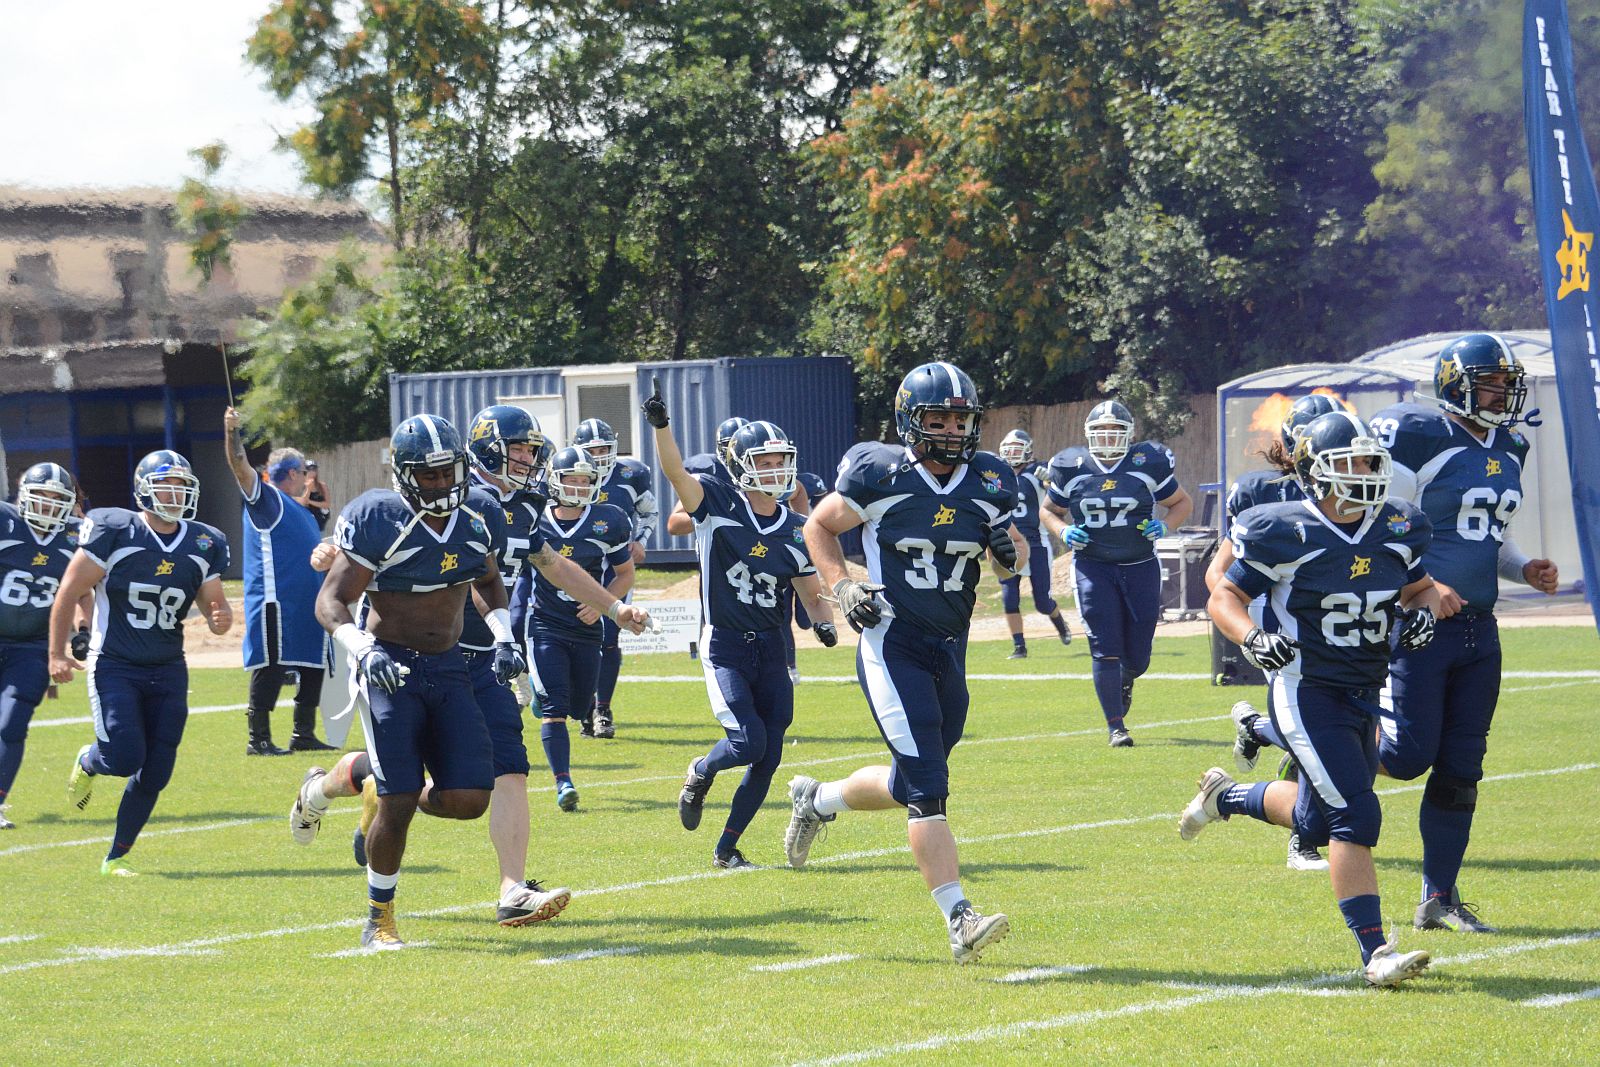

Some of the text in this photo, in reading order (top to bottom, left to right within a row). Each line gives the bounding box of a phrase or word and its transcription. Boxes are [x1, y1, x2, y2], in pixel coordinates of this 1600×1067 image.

[1535, 15, 1571, 206] FEAR THE
[1079, 497, 1139, 528] 67
[1456, 487, 1522, 542] 69
[0, 569, 59, 608] 63
[726, 560, 777, 608] 43
[895, 537, 983, 592] 37
[127, 582, 186, 630] 58
[1320, 589, 1398, 646] 25
